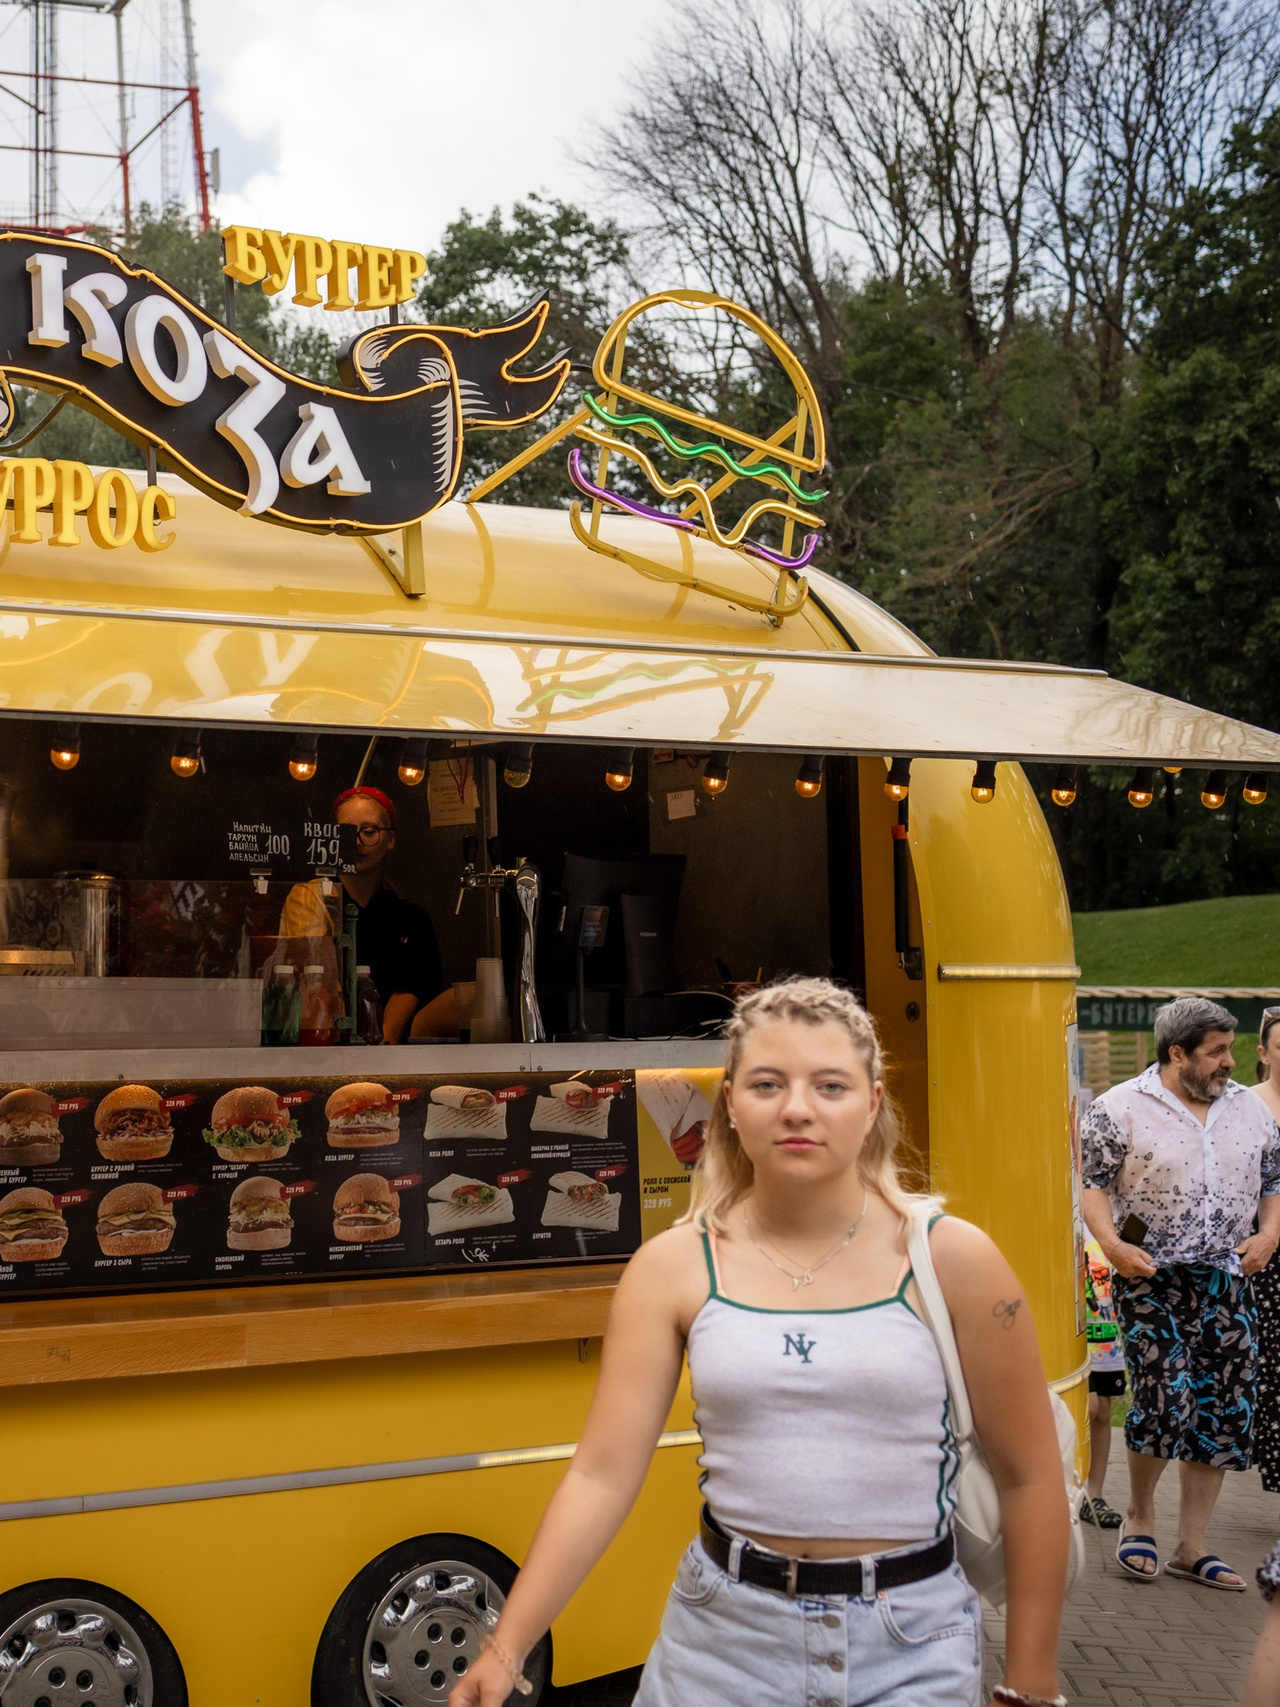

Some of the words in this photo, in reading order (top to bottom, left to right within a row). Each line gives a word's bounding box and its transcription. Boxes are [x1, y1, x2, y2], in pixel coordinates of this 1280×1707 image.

[221, 224, 430, 312] БУРГЕР
[25, 252, 372, 517] КОЗА
[227, 832, 257, 842] ТАРХУН
[265, 835, 290, 856] 100
[306, 838, 340, 866] 159
[229, 852, 269, 863] АПЕЛЬСИН
[509, 1090, 517, 1098] РУБ
[606, 1086, 615, 1094] РУБ
[402, 1093, 411, 1101] РУБ
[68, 1102, 79, 1110] РУБ
[176, 1099, 186, 1107] РУБ
[91, 1165, 109, 1173] БУРГЕР
[608, 1169, 616, 1177] РУБ
[511, 1175, 519, 1183] РУБ
[642, 1177, 657, 1186] РОЛЛ
[664, 1175, 692, 1184] СОСИСКОЙ
[177, 1190, 187, 1198] РУБ
[649, 1185, 669, 1194] СЫРОМ
[72, 1195, 82, 1203] РУБ
[658, 1198, 672, 1208] РУБ
[94, 1260, 112, 1268] БУРГЕР
[118, 1258, 132, 1266] СЫРА
[782, 1333, 817, 1364] NY
